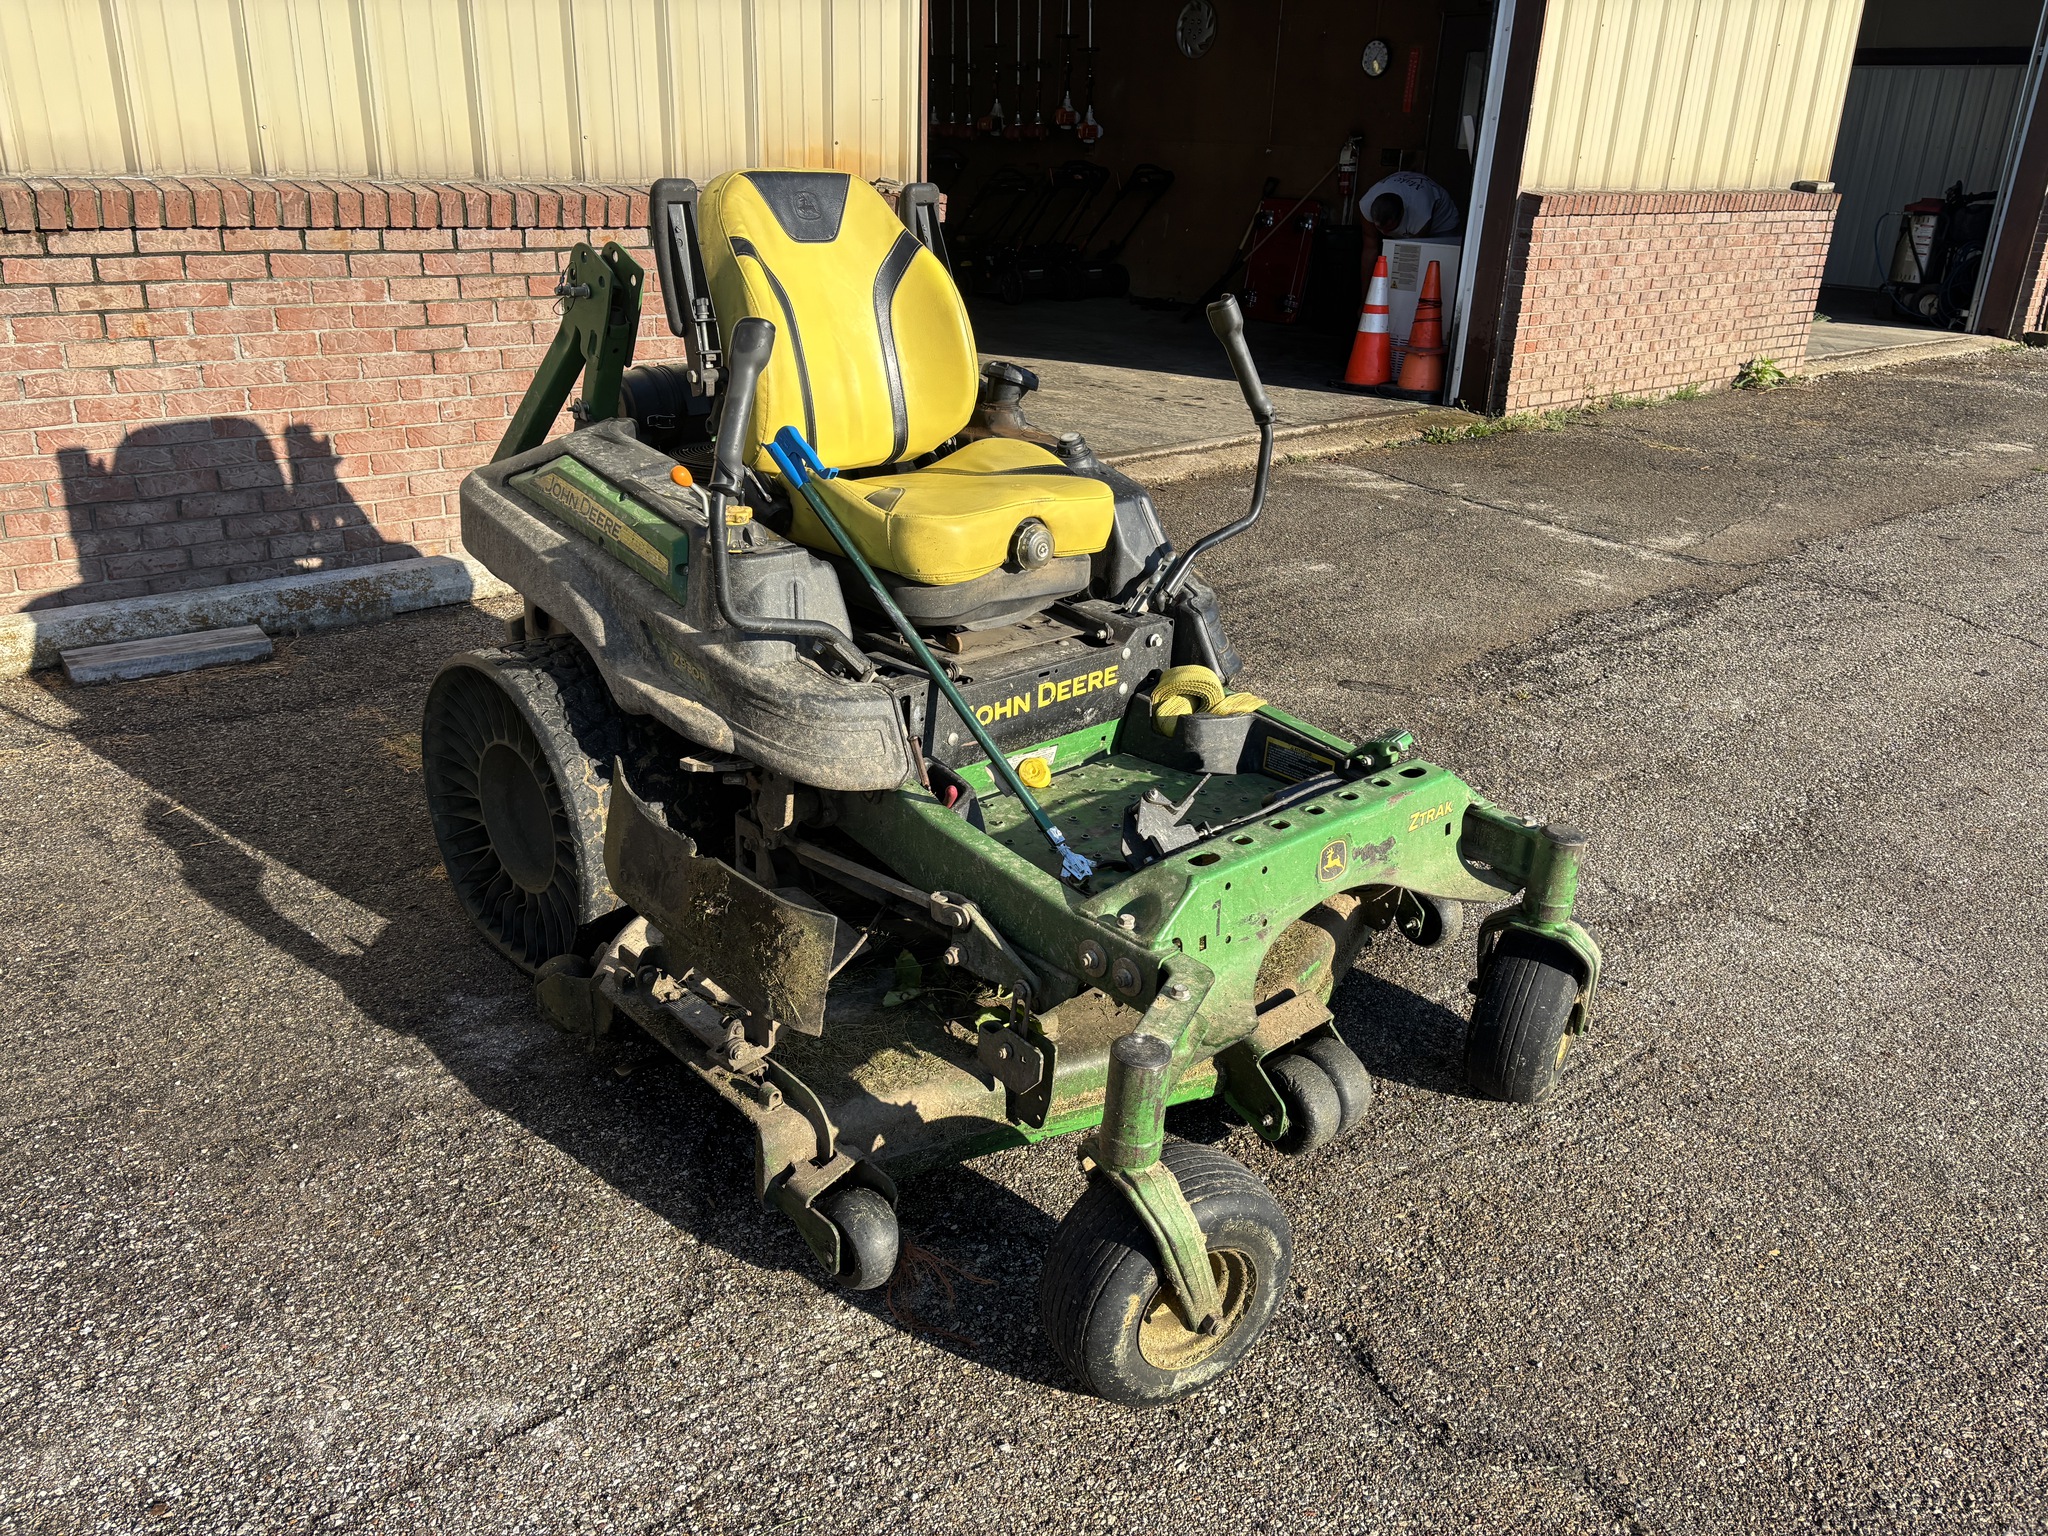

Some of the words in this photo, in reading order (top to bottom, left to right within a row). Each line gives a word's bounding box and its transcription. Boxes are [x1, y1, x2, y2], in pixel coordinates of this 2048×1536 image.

[544, 477, 580, 510] JOHN
[579, 496, 622, 539] DEERE
[968, 691, 1031, 727] OHN
[1037, 664, 1119, 709] DEERE
[1407, 801, 1454, 833] ZTRAK
